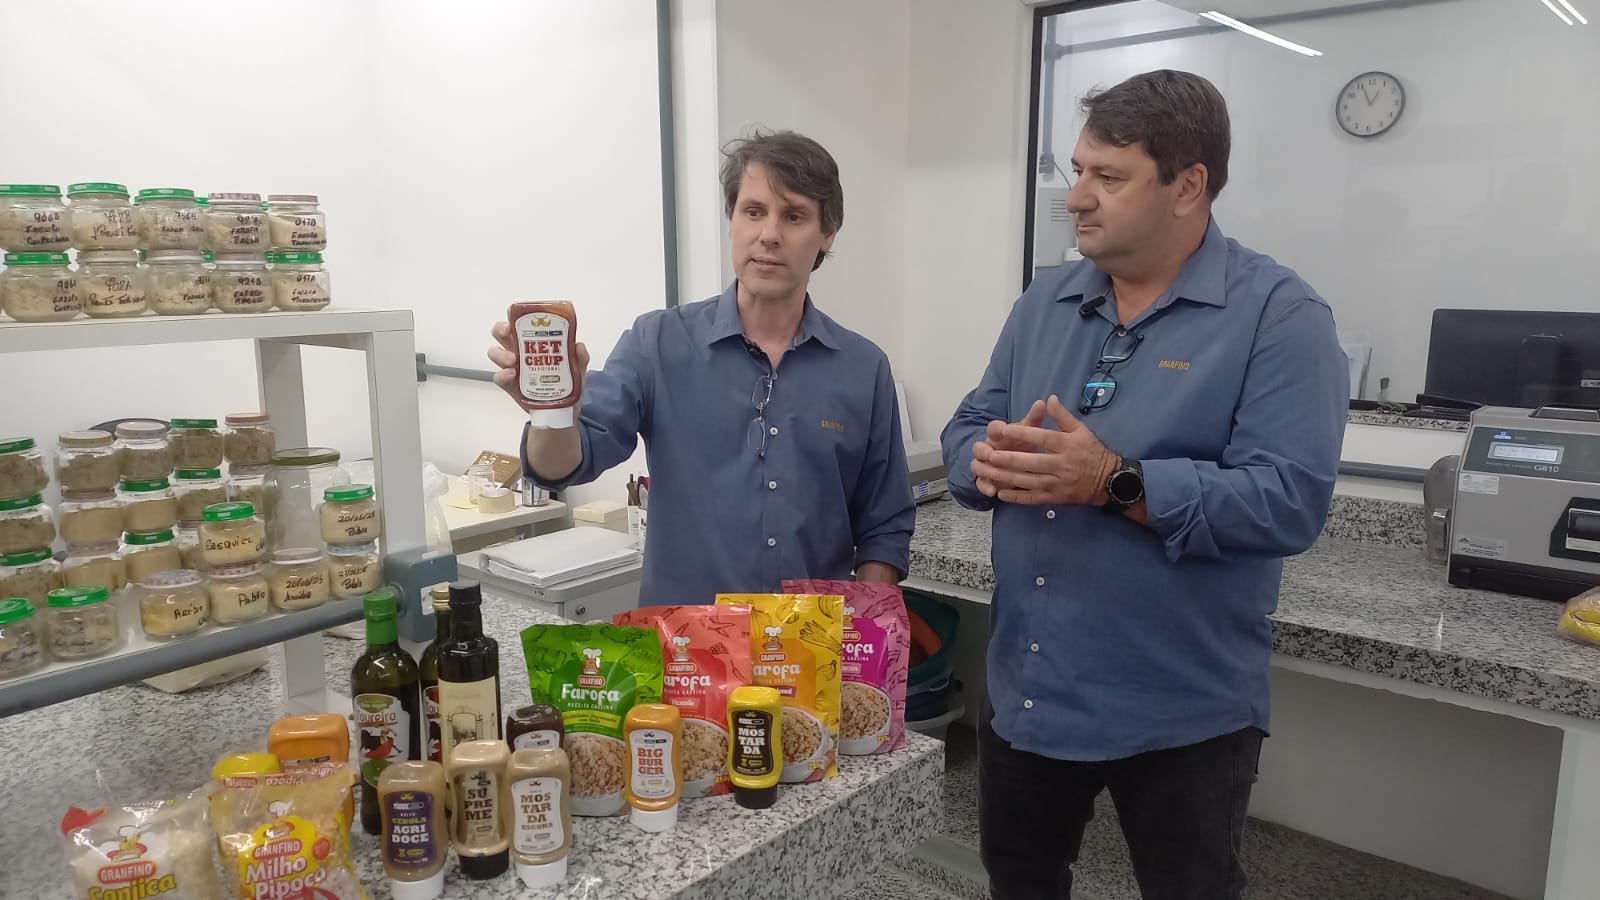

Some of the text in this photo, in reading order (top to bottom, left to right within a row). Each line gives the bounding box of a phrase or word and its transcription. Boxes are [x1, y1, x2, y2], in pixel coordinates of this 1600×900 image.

[524, 340, 562, 353] KET
[525, 355, 564, 366] CHUP
[753, 664, 801, 680] arofa
[664, 675, 712, 691] arofa
[561, 683, 620, 705] Farofa
[738, 727, 765, 737] MOS
[738, 736, 765, 746] TAR
[637, 748, 663, 758] BIG
[742, 746, 761, 755] DA
[638, 758, 663, 766] BUR
[638, 767, 664, 775] GER
[467, 788, 488, 800] SU
[520, 793, 551, 803] MOS
[464, 799, 493, 810] PRE
[521, 803, 551, 814] TAR
[464, 809, 493, 821] ME
[527, 813, 547, 824] DA
[393, 824, 427, 834] AGRI
[391, 833, 430, 844] DOCE
[254, 840, 300, 858] GRANFINO
[101, 863, 152, 880] GRANFINO
[246, 856, 306, 885] Milho
[255, 867, 327, 900] Pipoca
